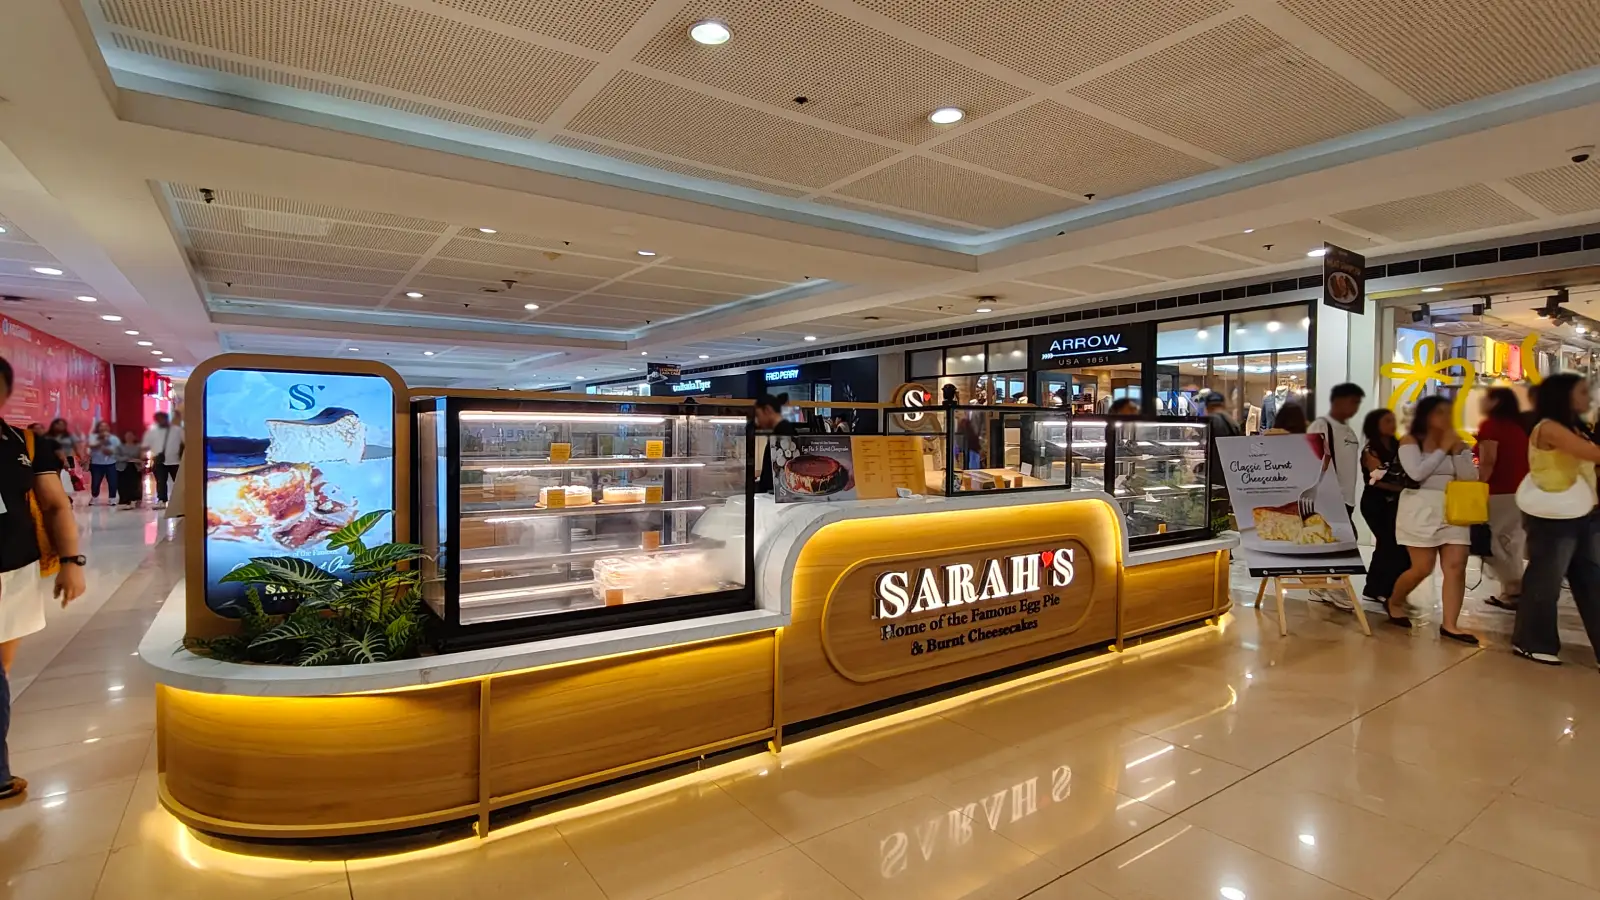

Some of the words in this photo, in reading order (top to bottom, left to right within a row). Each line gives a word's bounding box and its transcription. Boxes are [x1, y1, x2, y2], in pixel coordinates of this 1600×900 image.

[1049, 333, 1121, 352] ARROW
[1058, 358, 1080, 366] USA
[1087, 356, 1109, 364] 1851
[765, 371, 779, 381] FRED
[780, 369, 799, 380] PERRY
[1229, 459, 1262, 474] Classic
[1263, 459, 1293, 471] Burnt
[1241, 471, 1289, 485] Cheesecake
[876, 547, 1075, 620] SARAH'S
[880, 622, 926, 641] Home
[930, 614, 943, 631] of
[947, 611, 968, 627] the
[971, 605, 1017, 623] Famous
[1019, 598, 1041, 614] Egg
[1042, 594, 1060, 608] Pie
[910, 641, 923, 656] &
[926, 633, 965, 653] Burnt
[967, 618, 1038, 643] Cheesecakes
